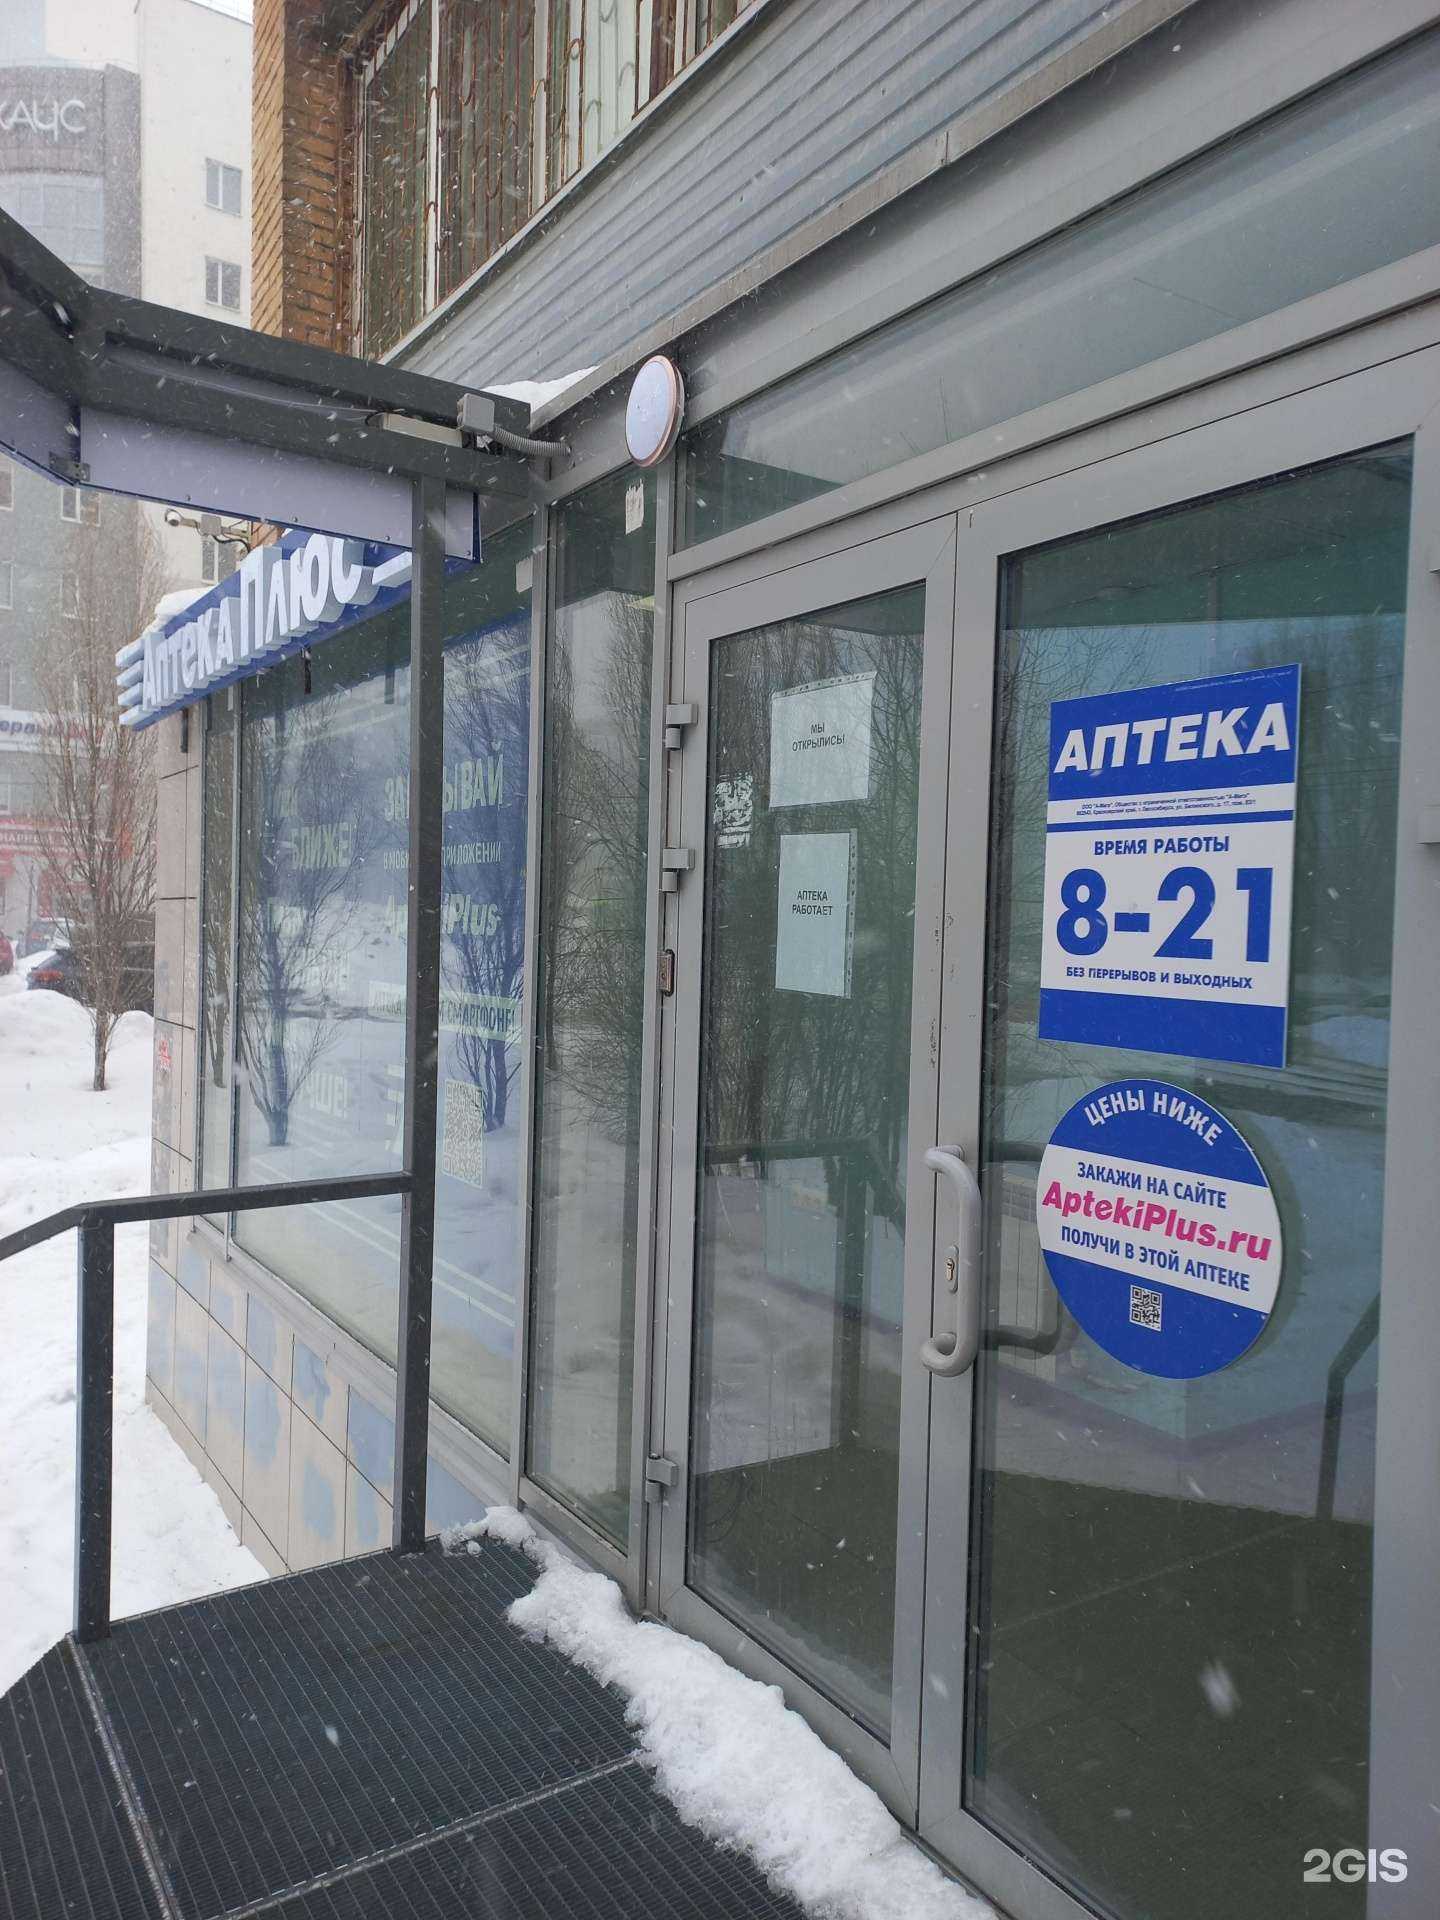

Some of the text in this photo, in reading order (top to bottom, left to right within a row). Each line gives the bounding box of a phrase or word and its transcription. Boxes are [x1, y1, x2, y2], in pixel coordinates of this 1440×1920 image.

[811, 722, 825, 734] МЫ
[1054, 702, 1290, 774] АПТЕКА
[1094, 835, 1230, 856] ВРЕМЯ РАБОТЫ
[792, 904, 833, 915] РАБОТАЕТ
[797, 890, 828, 901] АПТЕКА
[1066, 966, 1253, 989] БЕЗ ПЕРЕРЫВОВ И ВЫХОДНЫХ
[1084, 1089, 1223, 1147] ЦЕНЫ НИЖЕ
[1077, 1161, 1227, 1209] ЗАКАЖИ НА САЙТЕ
[1042, 1180, 1272, 1261] AptekiPlus.ru
[1061, 1225, 1250, 1292] ПОЛУЧИ В ЭТОЙ АПТЕКЕ
